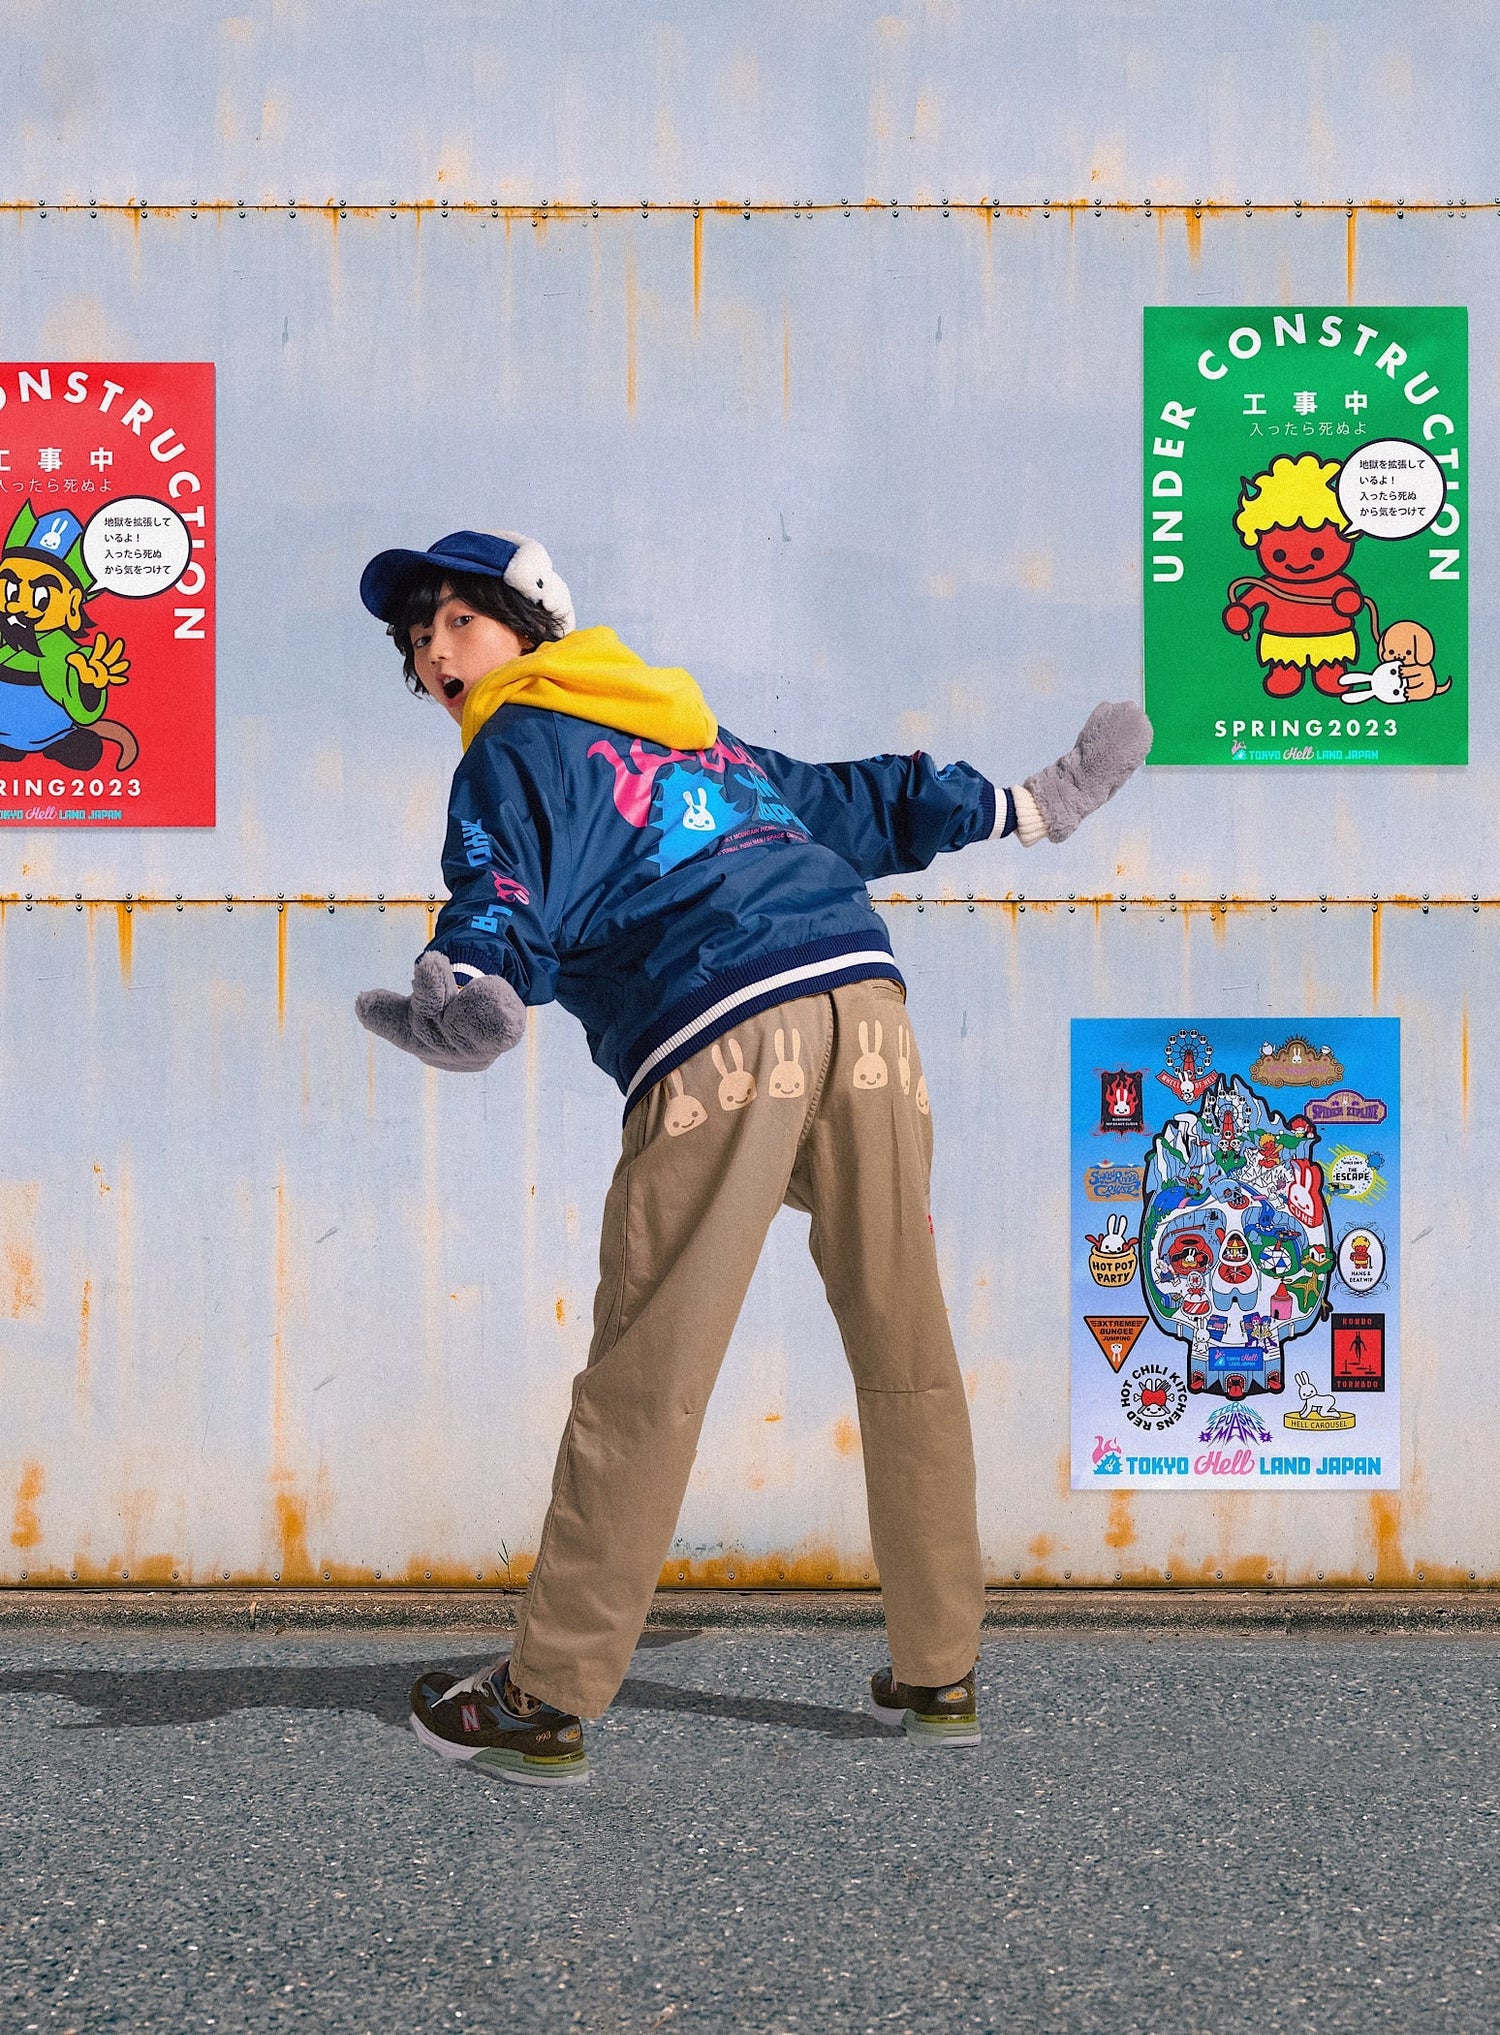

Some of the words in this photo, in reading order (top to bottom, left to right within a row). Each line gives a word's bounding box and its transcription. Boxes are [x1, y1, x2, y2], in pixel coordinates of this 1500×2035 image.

[1243, 390, 1368, 416] 工事中
[1250, 421, 1367, 436] 入ったら死ぬよ
[1359, 459, 1426, 470] 地獄を拡張して
[1152, 400, 1197, 582] UNDER
[1359, 491, 1417, 501] 入ったら死ぬ
[0, 369, 206, 639] NSTRUCTON
[1359, 507, 1426, 517] から気をつけて
[104, 517, 171, 528] 地獄を拡張して
[104, 549, 162, 560] 入ったら死ぬ
[104, 565, 171, 576] から気をつけて
[1214, 719, 1398, 738] SPRING2023
[1249, 750, 1281, 760] TOKYO
[1282, 746, 1315, 761] Hell
[1316, 750, 1342, 760] LAND
[1345, 750, 1379, 760] JAPAN
[25, 805, 57, 820] Hell
[58, 809, 86, 820] LAND
[88, 809, 122, 820] JAPAN
[1162, 1075, 1180, 1089] WHEEL
[1194, 1082, 1203, 1090] OF
[1203, 1074, 1217, 1087] HELL
[1335, 1172, 1370, 1181] ESCAPE
[1290, 1203, 1314, 1227] CUNE
[1092, 1261, 1112, 1272] HOT
[1114, 1259, 1135, 1272] POT
[1096, 1271, 1131, 1283] PARTY
[1132, 1364, 1168, 1379] CHILI
[1336, 1380, 1379, 1389] TORNADO
[1120, 1379, 1133, 1407] HOT
[1156, 1371, 1188, 1431] KITCHENS
[1126, 1410, 1152, 1430] RED
[1291, 1420, 1309, 1428] HELL
[1310, 1420, 1347, 1429] CAROUSEL
[1125, 1456, 1189, 1476] TOKYO
[1193, 1449, 1256, 1476] Hell
[1259, 1456, 1311, 1476] LAND
[1316, 1456, 1382, 1476] JAPAN
[461, 1704, 481, 1732] N
[535, 1730, 552, 1743] 993
